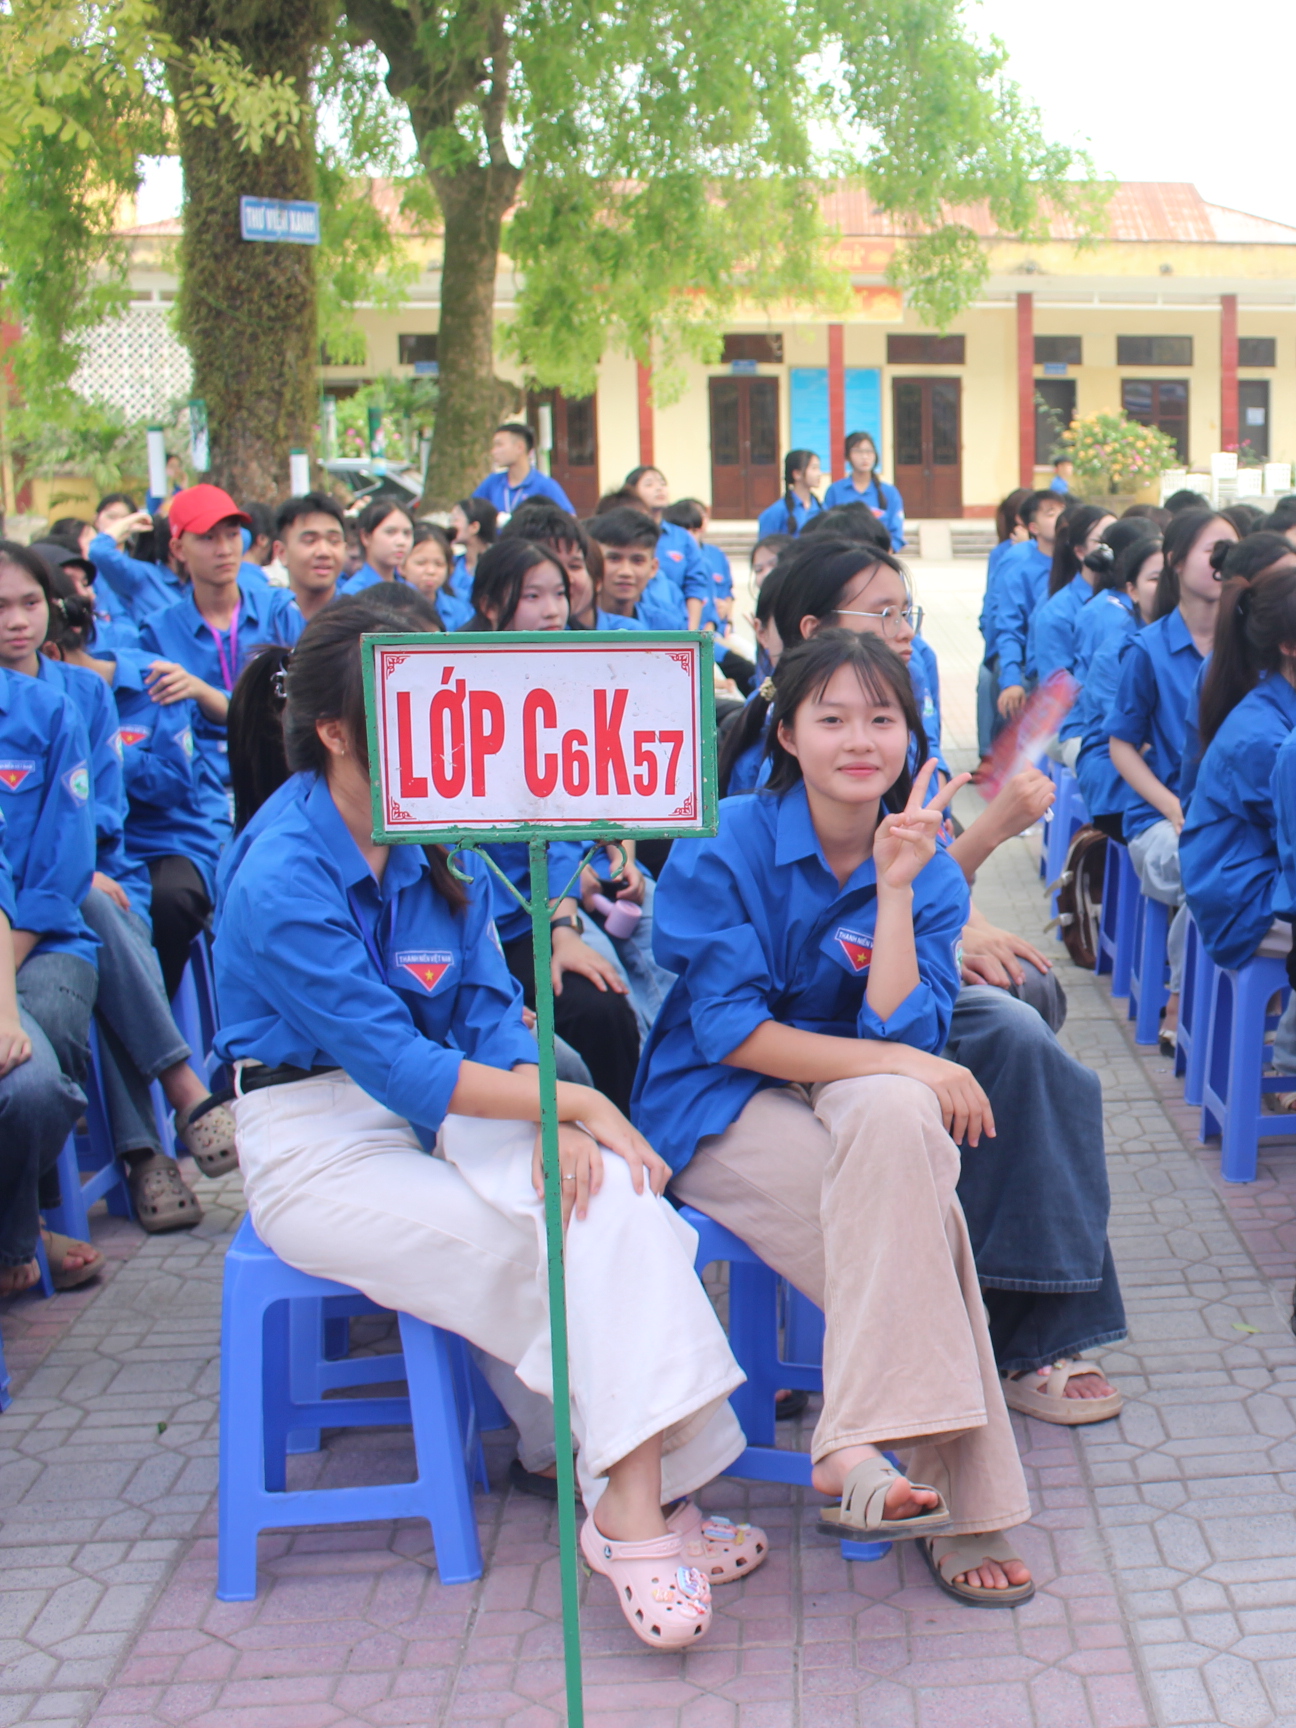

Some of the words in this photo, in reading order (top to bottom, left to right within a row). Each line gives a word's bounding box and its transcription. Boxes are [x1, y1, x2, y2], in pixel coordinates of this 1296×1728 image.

[289, 209, 316, 234] XANH
[396, 666, 505, 799] LỚP
[522, 688, 684, 798] C6K57
